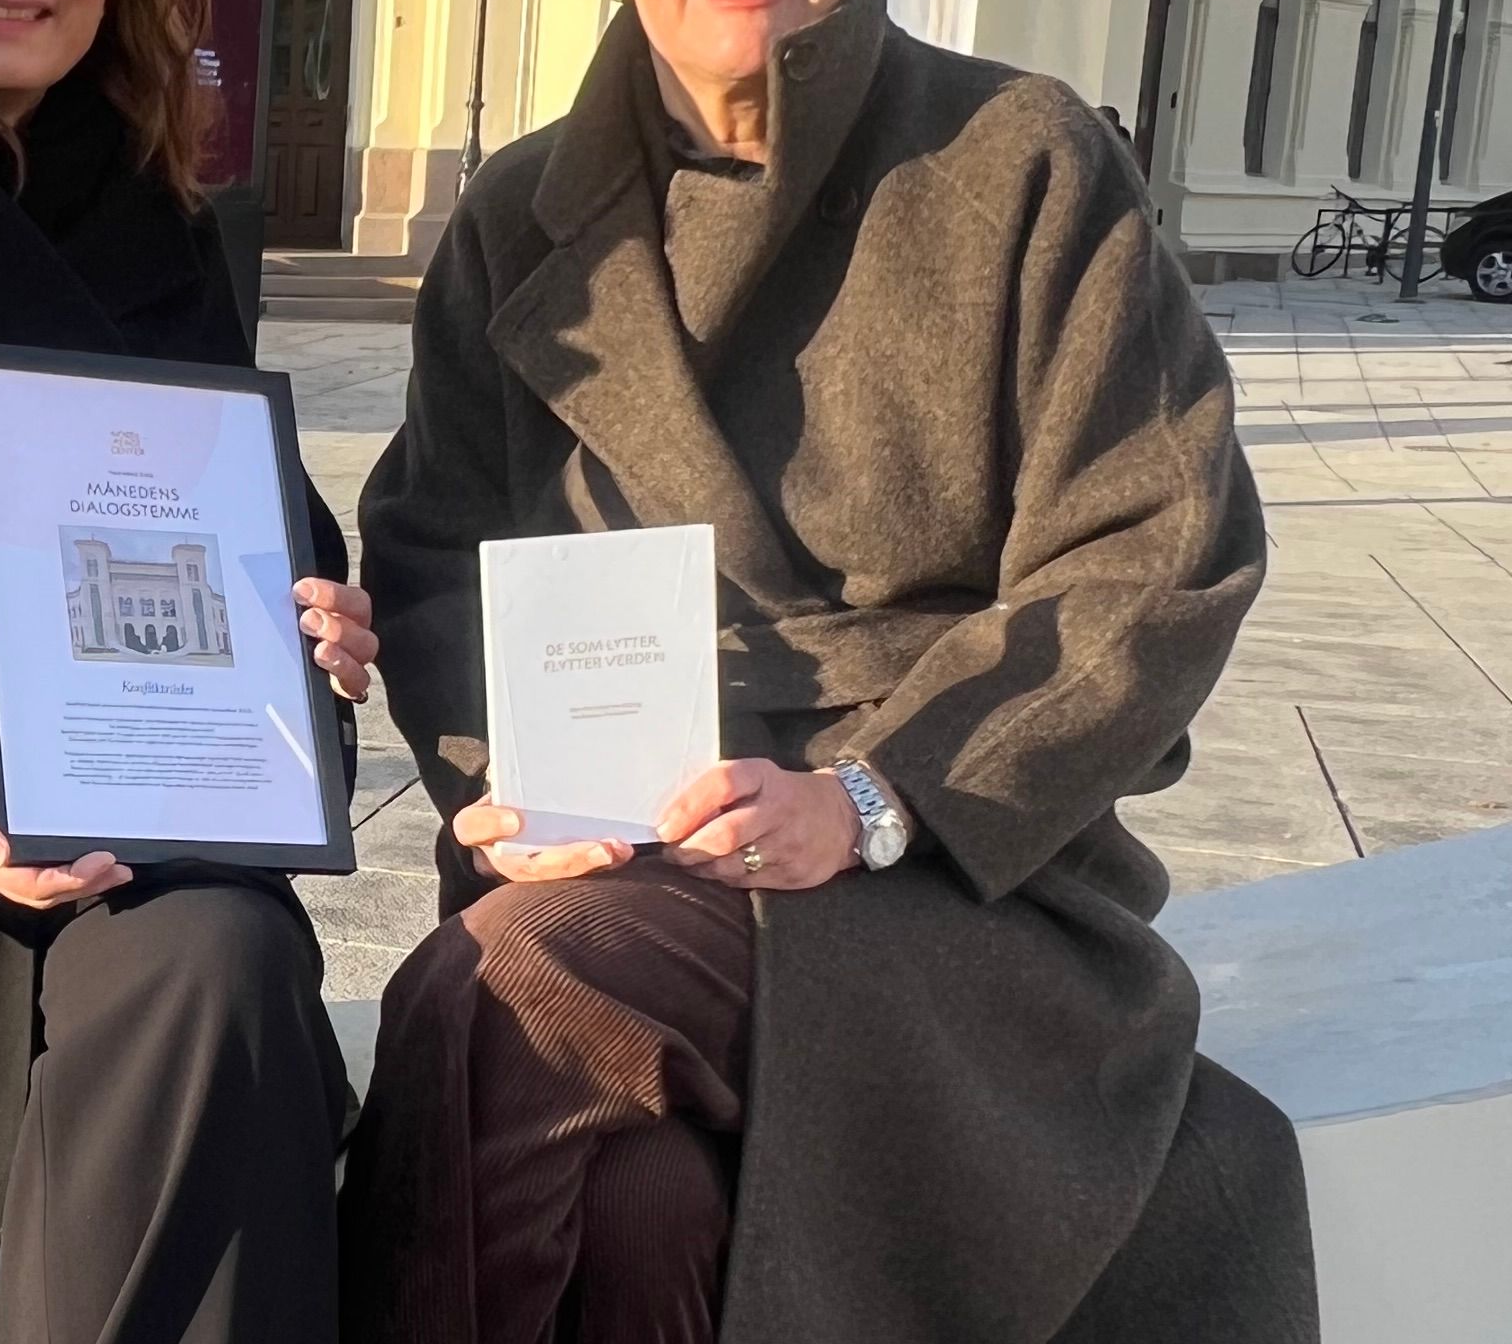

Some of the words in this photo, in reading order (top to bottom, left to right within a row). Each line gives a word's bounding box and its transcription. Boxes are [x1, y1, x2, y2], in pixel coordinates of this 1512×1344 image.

[87, 481, 180, 501] MÅNEDENS
[69, 500, 201, 521] DIALOGSTEMME
[545, 643, 563, 657] DE
[568, 637, 604, 654] SOM
[543, 656, 602, 673] FLYTTER
[606, 651, 666, 668] VERDEN
